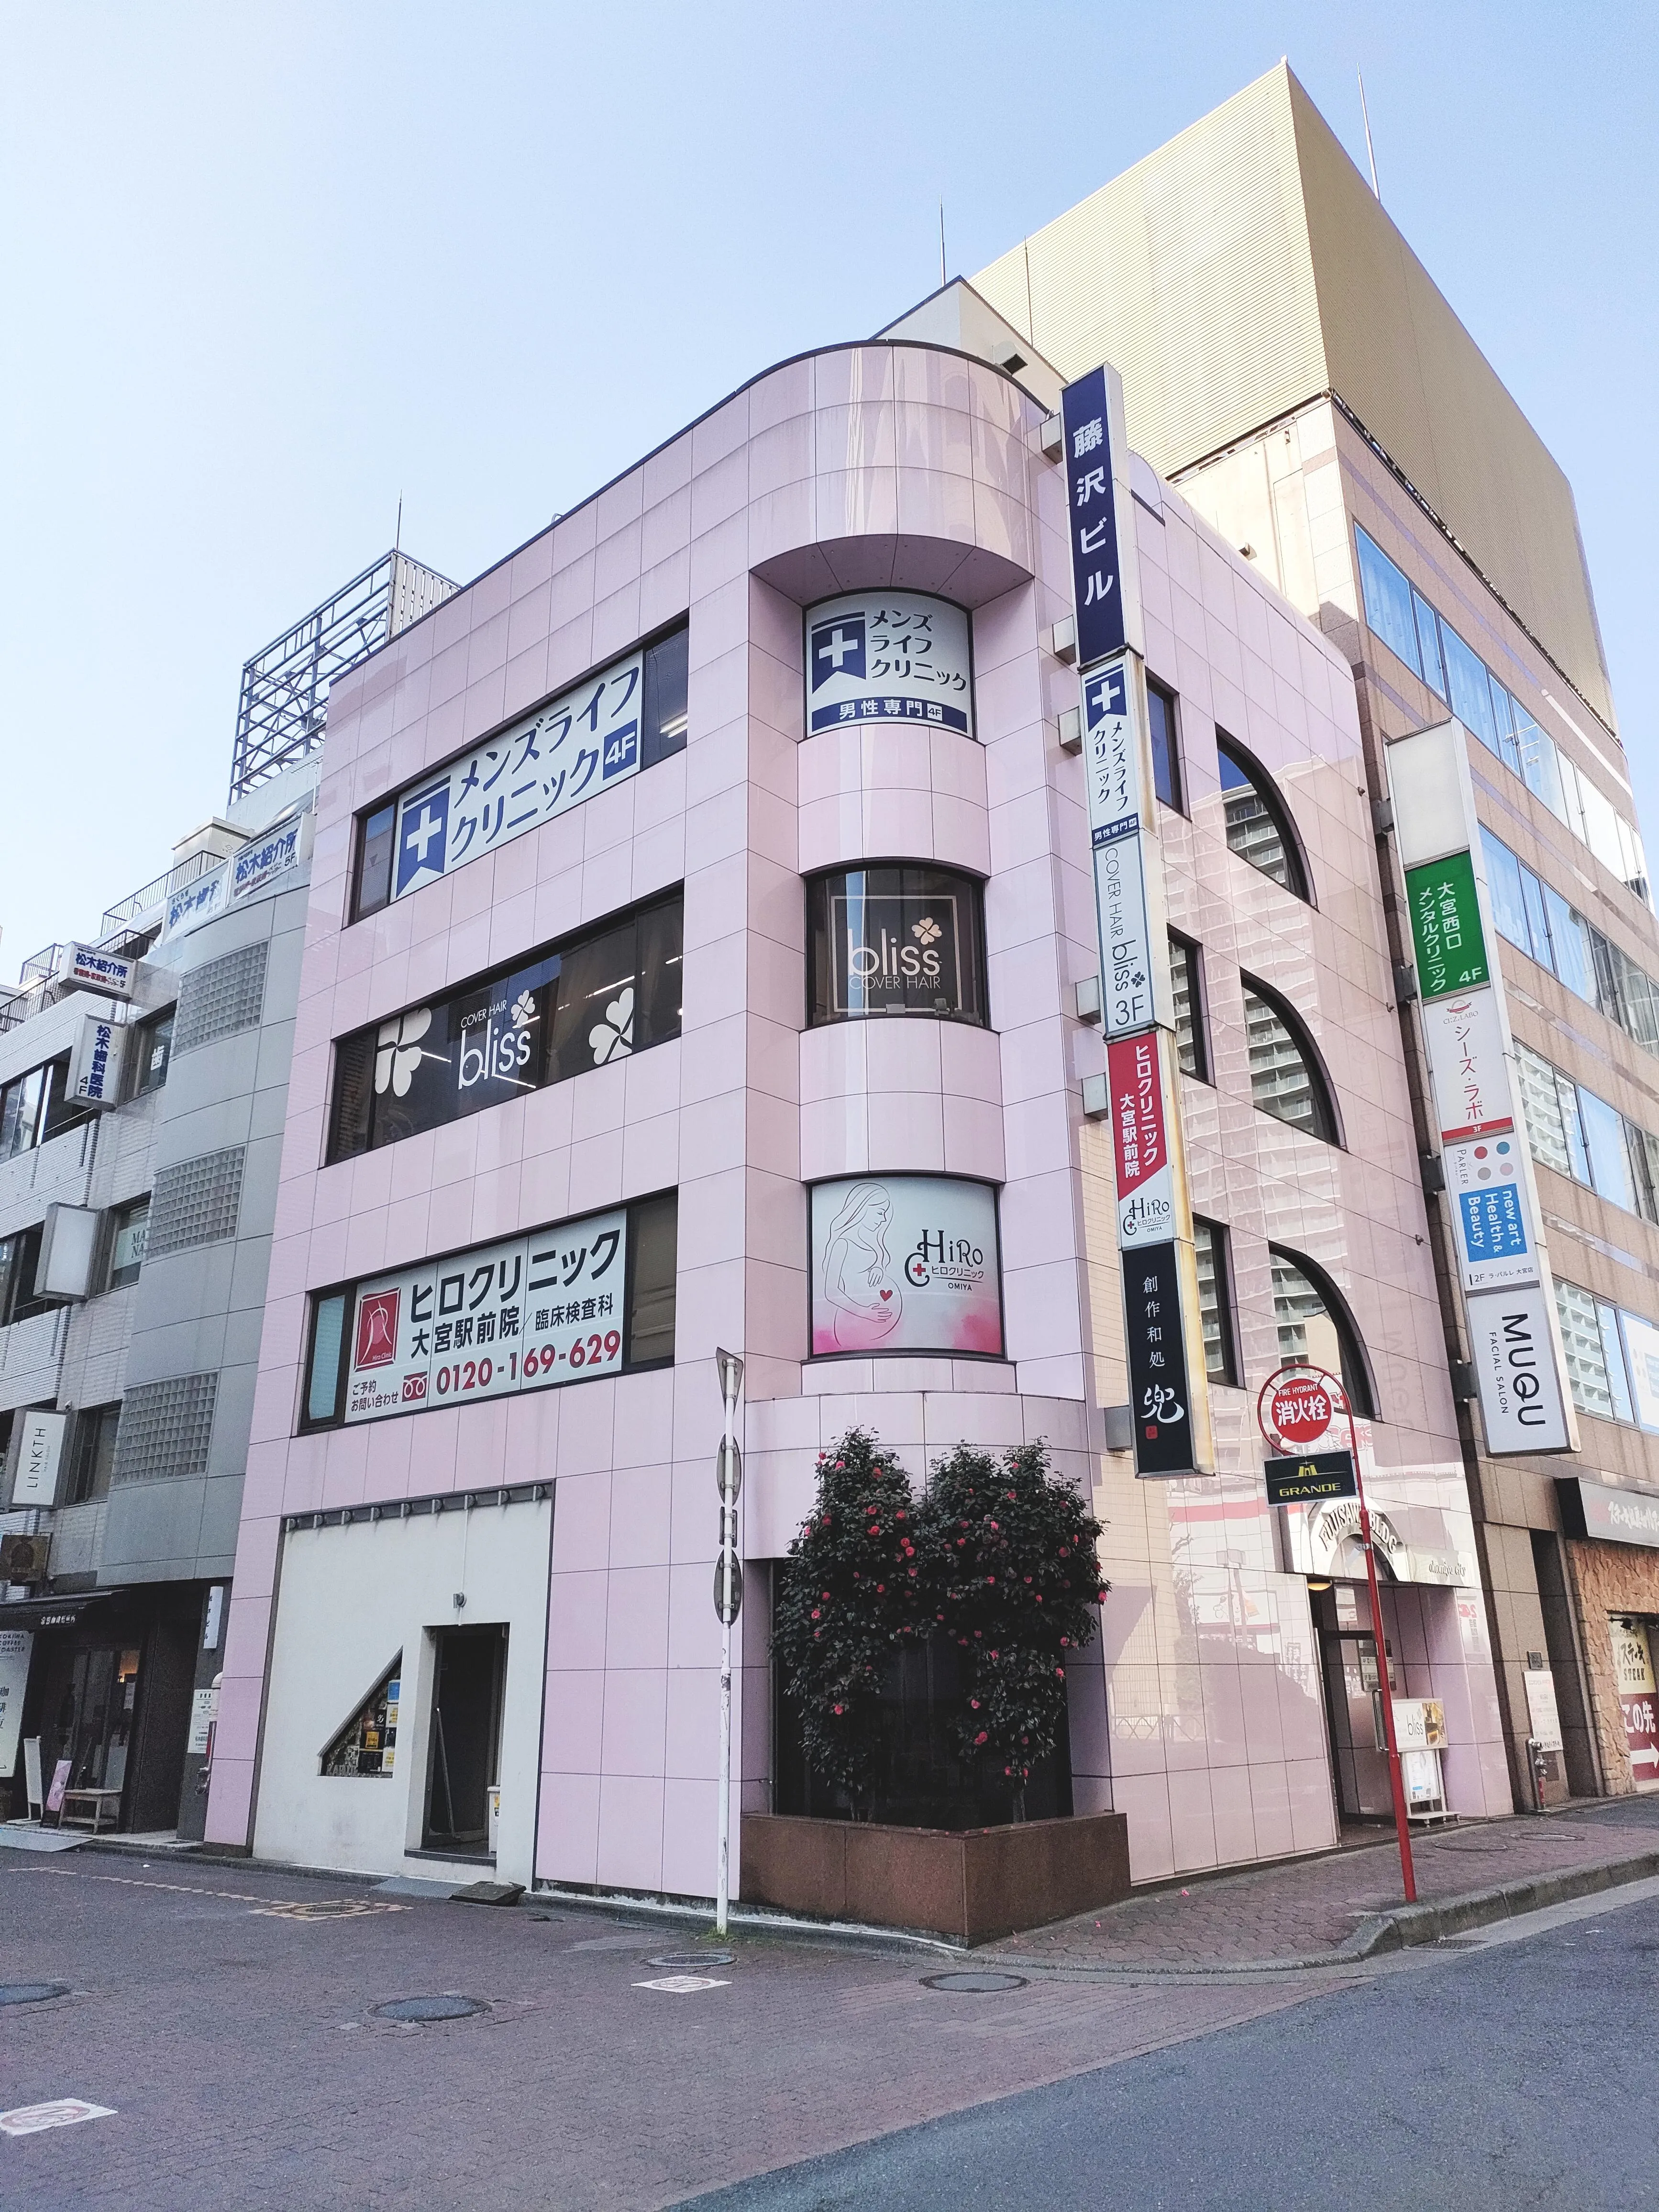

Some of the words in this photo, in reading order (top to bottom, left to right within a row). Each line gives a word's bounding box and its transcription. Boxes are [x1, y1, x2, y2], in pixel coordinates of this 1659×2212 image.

[1073, 417, 1114, 606] 藤沢ビル
[869, 610, 933, 631] メンズ
[870, 635, 932, 654] ライフ
[871, 659, 967, 691] クリニック
[839, 699, 922, 720] 男性専門
[928, 708, 941, 717] 4F
[454, 666, 640, 809] メンズライフ
[1094, 730, 1110, 804] クリニック
[1111, 721, 1128, 812] メンズライフ
[451, 749, 599, 863] クリニック
[604, 730, 636, 766] 4F
[1094, 820, 1128, 841] 男性専門
[235, 828, 299, 884] 松木紹介所
[284, 852, 296, 867] 5F
[1105, 848, 1122, 900] COVER
[1109, 902, 1124, 939] HAIR
[1437, 882, 1462, 950] 大宮西口
[847, 928, 940, 976] bliss
[1418, 887, 1446, 992] メンタルクリニック
[76, 952, 128, 978] 松木紹介所
[850, 976, 901, 989] COVER
[907, 976, 941, 989] HAIR
[1112, 939, 1138, 992] bliss
[1459, 966, 1482, 982] 4F
[461, 1008, 487, 1029] COVER
[488, 1000, 507, 1016] HAIR
[1115, 994, 1145, 1026] 3F
[88, 1025, 111, 1099] 松木歯科医院
[150, 1045, 165, 1071] 歯
[458, 1019, 531, 1091] bliss
[1455, 1026, 1483, 1120] シーズ・ラボ
[1135, 1045, 1158, 1167] ヒロクリニック
[1119, 1093, 1140, 1179] 大宮駅前院
[1457, 1149, 1469, 1185] PARLER
[1138, 1215, 1171, 1226] ヒロクリニック
[1468, 1196, 1484, 1249] Beauty
[1485, 1193, 1505, 1242] Health
[1502, 1190, 1516, 1221] new
[1493, 1244, 1503, 1253] &
[1508, 1222, 1522, 1246] art
[411, 1229, 620, 1323] ヒロクリニック
[931, 1265, 984, 1279] ヒロクリニック
[948, 1282, 973, 1291] OMIYA
[1474, 1273, 1485, 1283] 2F
[1515, 1267, 1534, 1275] 大宮店
[411, 1305, 521, 1359] 大宮駅前院
[535, 1293, 613, 1331] 臨床検査科
[1142, 1275, 1166, 1369] 創作和処
[436, 1330, 621, 1395] 0120-169-629
[1489, 1331, 1502, 1371] FACIAL
[1496, 1376, 1509, 1414] SALON
[1502, 1313, 1546, 1426] MUQU
[351, 1391, 398, 1412] お問い合わせ
[353, 1379, 376, 1395] ご予約
[1140, 1383, 1185, 1424] 兜
[1278, 1388, 1291, 1397] FIRE
[1292, 1383, 1318, 1394] HYDRANT
[1274, 1394, 1328, 1427] 消火栓
[26, 1428, 46, 1488] LINKTH
[1279, 1482, 1341, 1497] GRANDE
[1319, 1502, 1361, 1552] FUJISAW
[1368, 1509, 1397, 1554] BLDG
[1623, 1668, 1645, 1681] STEAK
[1406, 1714, 1423, 1736] bliss
[1622, 1701, 1656, 1734] この先
